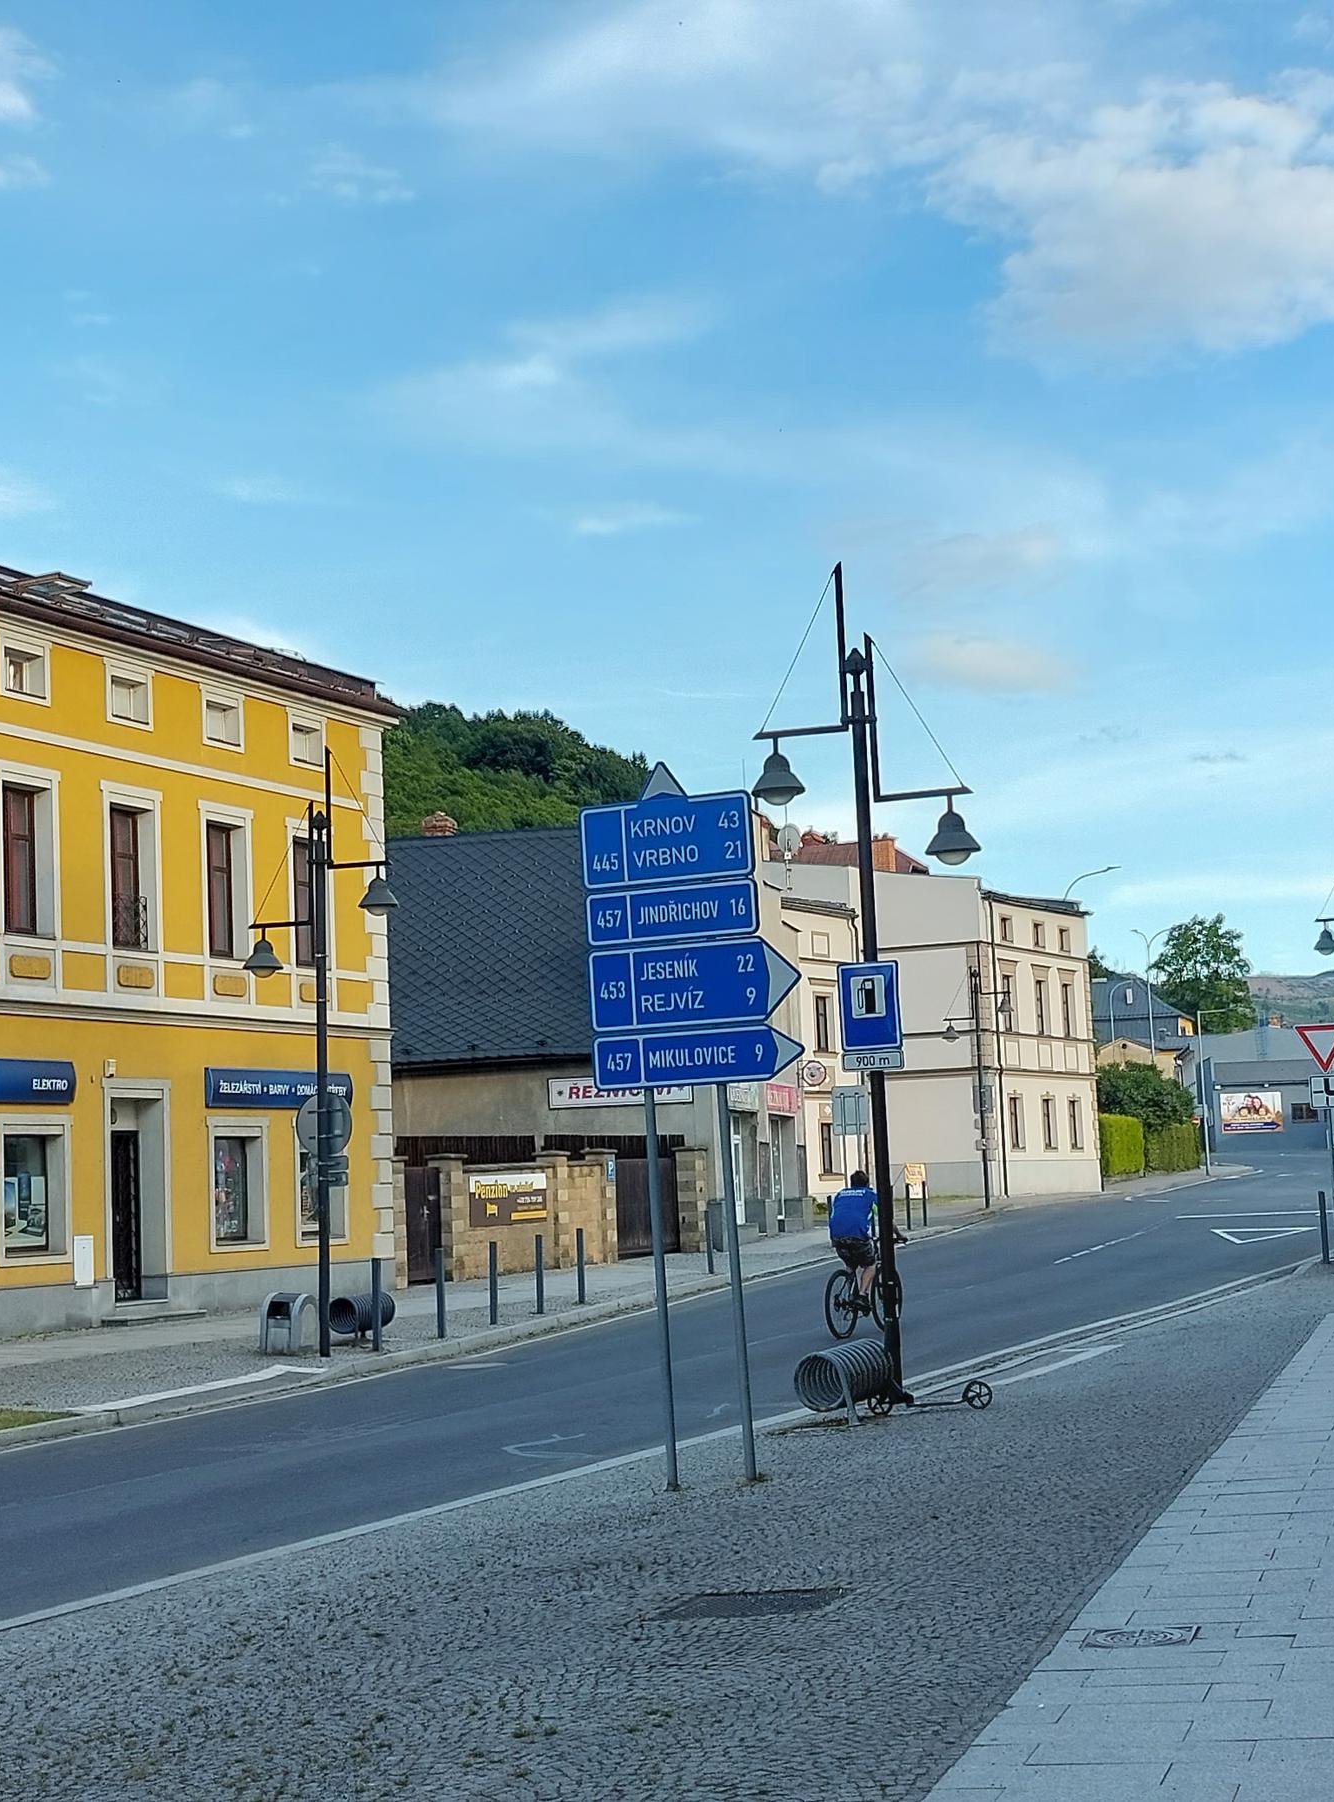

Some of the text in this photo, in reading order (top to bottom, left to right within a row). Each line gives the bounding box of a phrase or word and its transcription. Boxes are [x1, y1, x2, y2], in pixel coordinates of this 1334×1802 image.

[630, 811, 739, 838] KRNOV 43
[593, 853, 619, 872] 445
[633, 840, 742, 868] VRBNO 21
[597, 898, 746, 929] 457 JINDŘICHOV 16
[640, 953, 755, 981] JESENÍK 22
[600, 981, 626, 1000] 453
[641, 986, 756, 1013] REJVÍZ 9
[607, 1044, 763, 1072] 457 MIKULOVICE 9
[856, 1056, 890, 1067] 900 m
[32, 1078, 68, 1091] ELEKTRO
[269, 1084, 290, 1096] BARVY
[297, 1083, 318, 1096] DOMÁC
